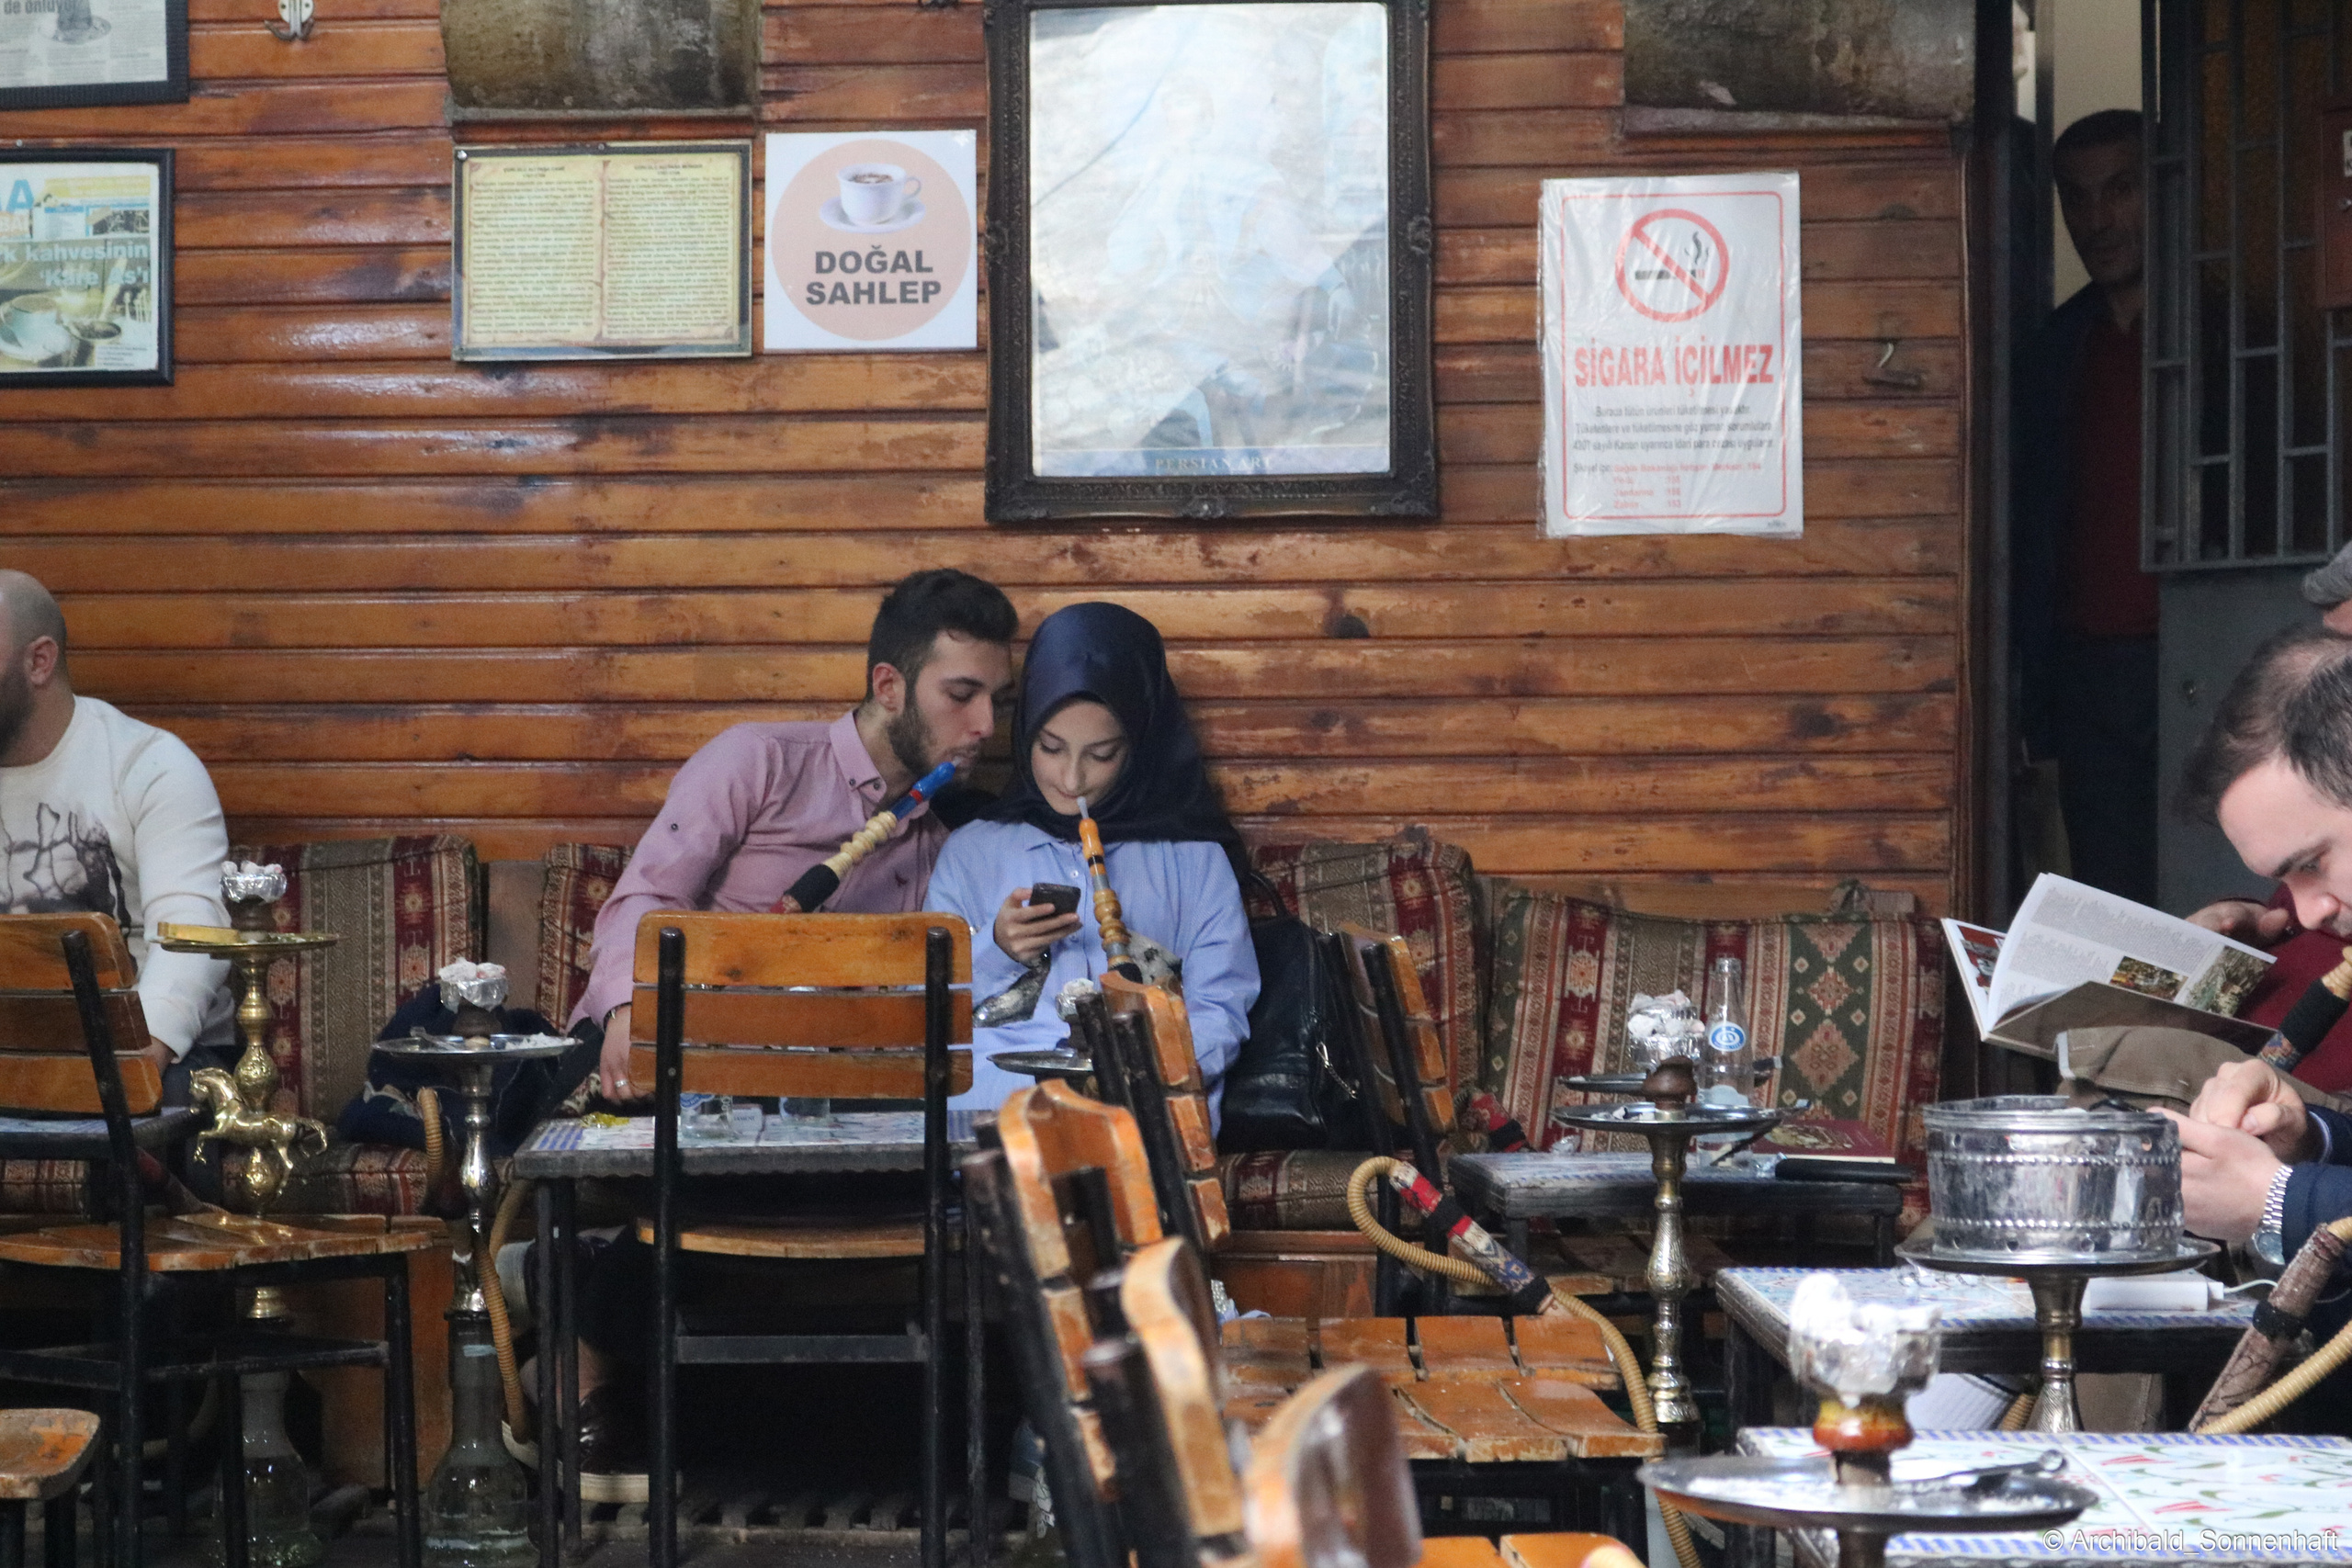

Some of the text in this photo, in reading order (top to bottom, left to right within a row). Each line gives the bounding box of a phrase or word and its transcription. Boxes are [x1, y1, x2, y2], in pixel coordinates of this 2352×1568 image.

[815, 245, 933, 274] DOĞAL
[806, 281, 942, 305] SAHLEP
[1575, 335, 1774, 398] SİGARA İÇİLMEZ
